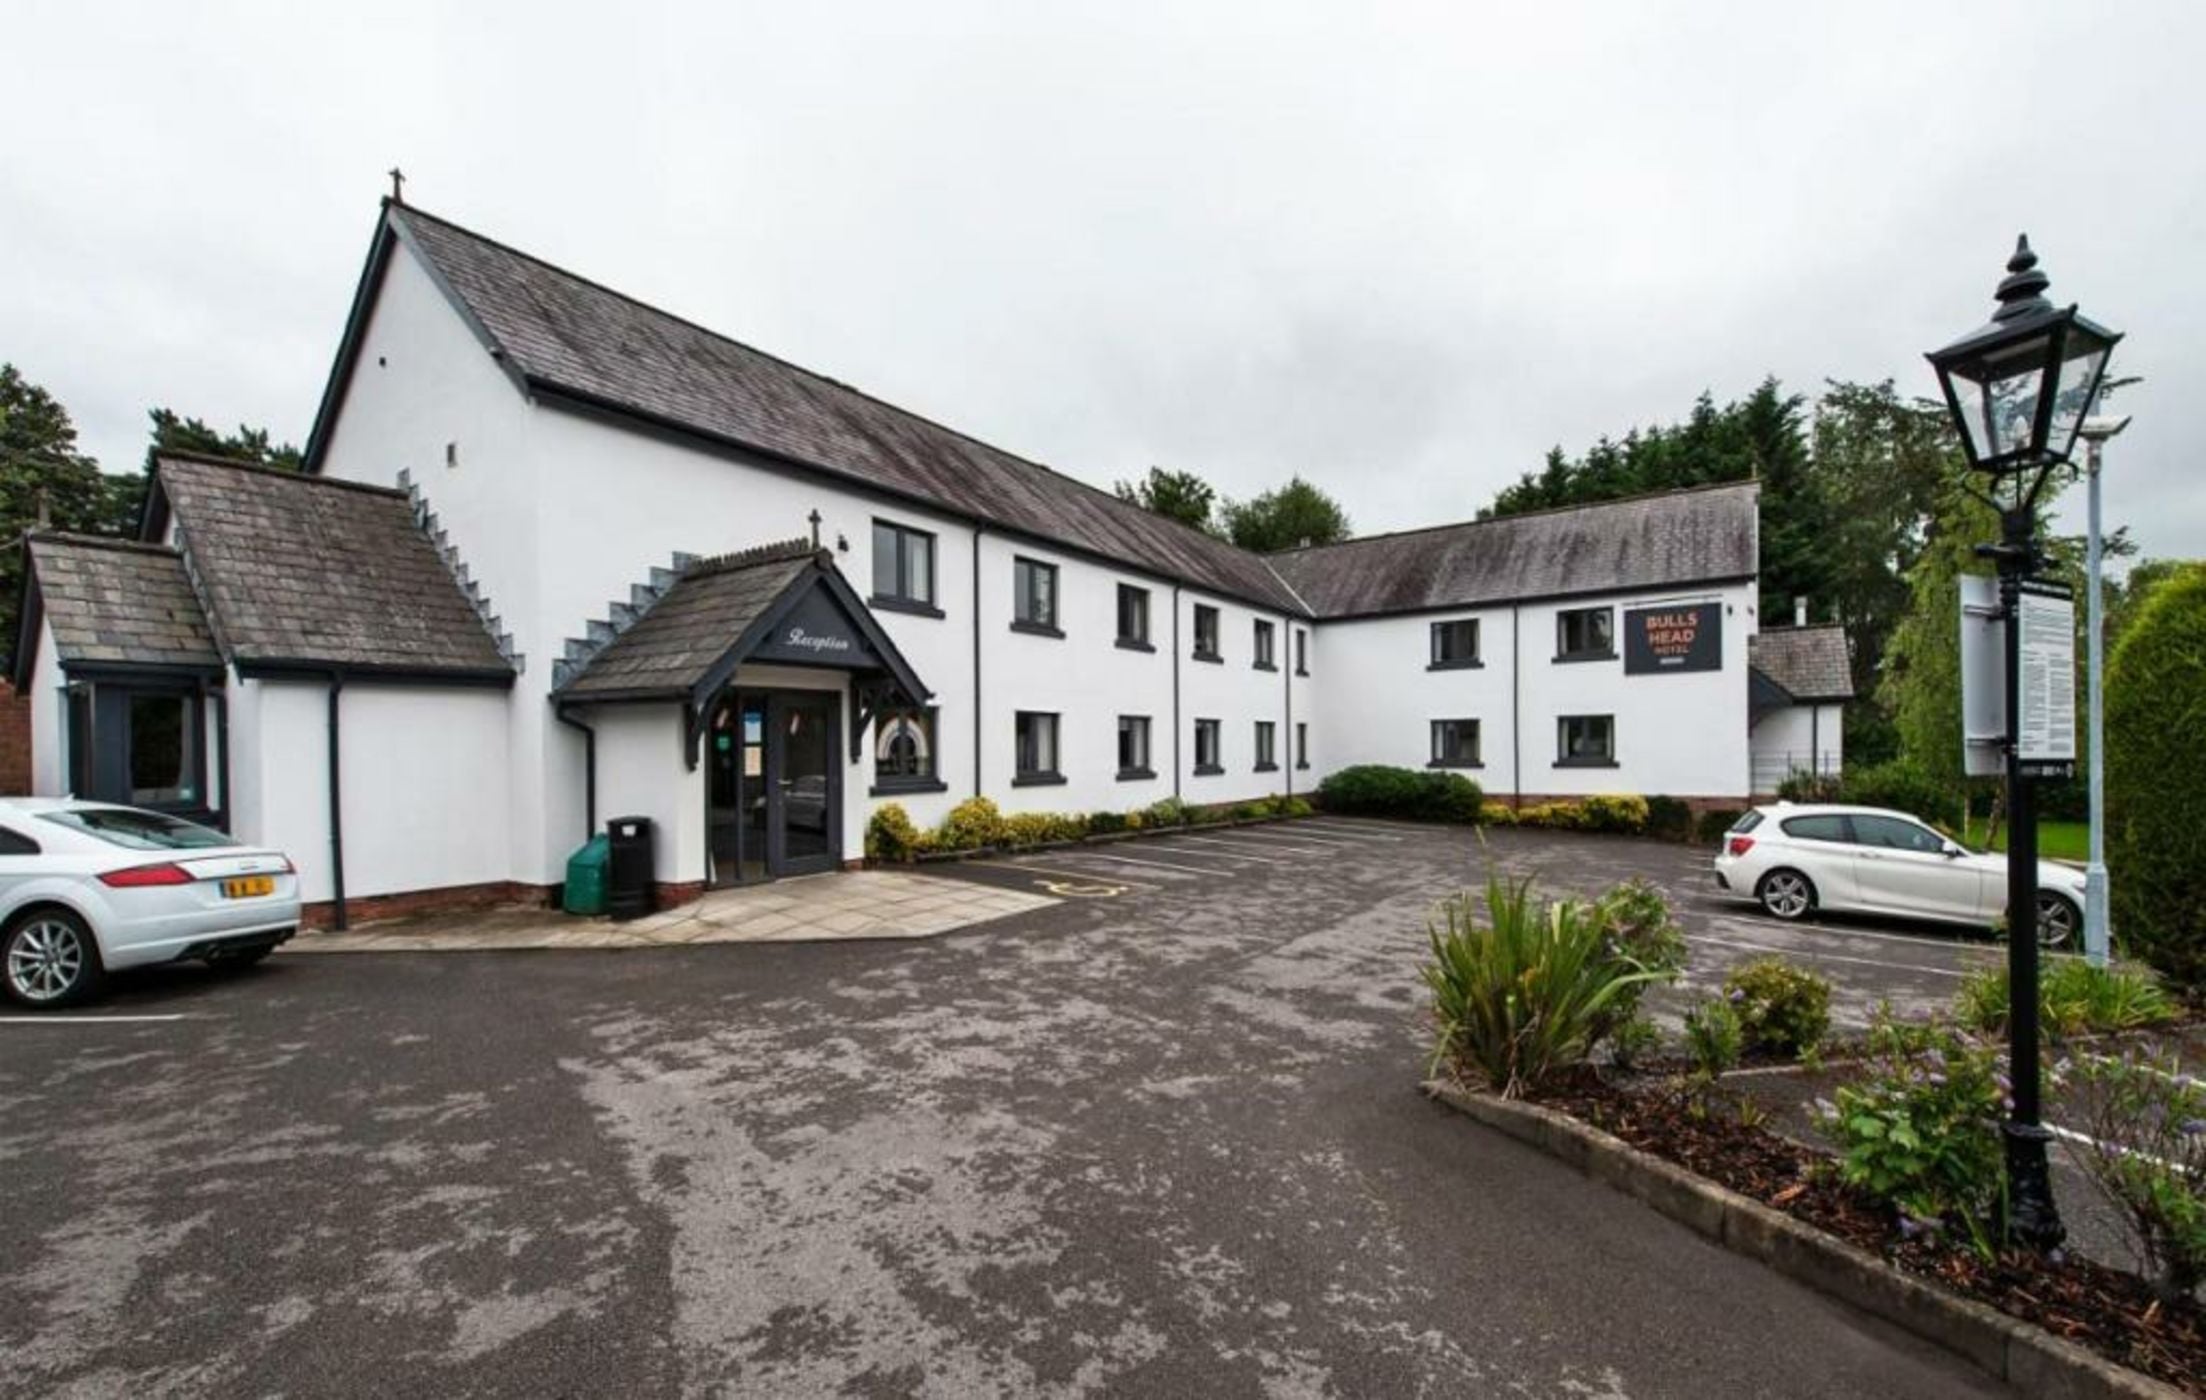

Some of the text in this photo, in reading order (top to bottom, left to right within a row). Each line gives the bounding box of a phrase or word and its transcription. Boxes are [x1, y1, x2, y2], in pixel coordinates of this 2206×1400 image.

[1646, 612, 1698, 630] BULLS
[786, 627, 849, 651] Reception
[1649, 629, 1695, 645] HEAD
